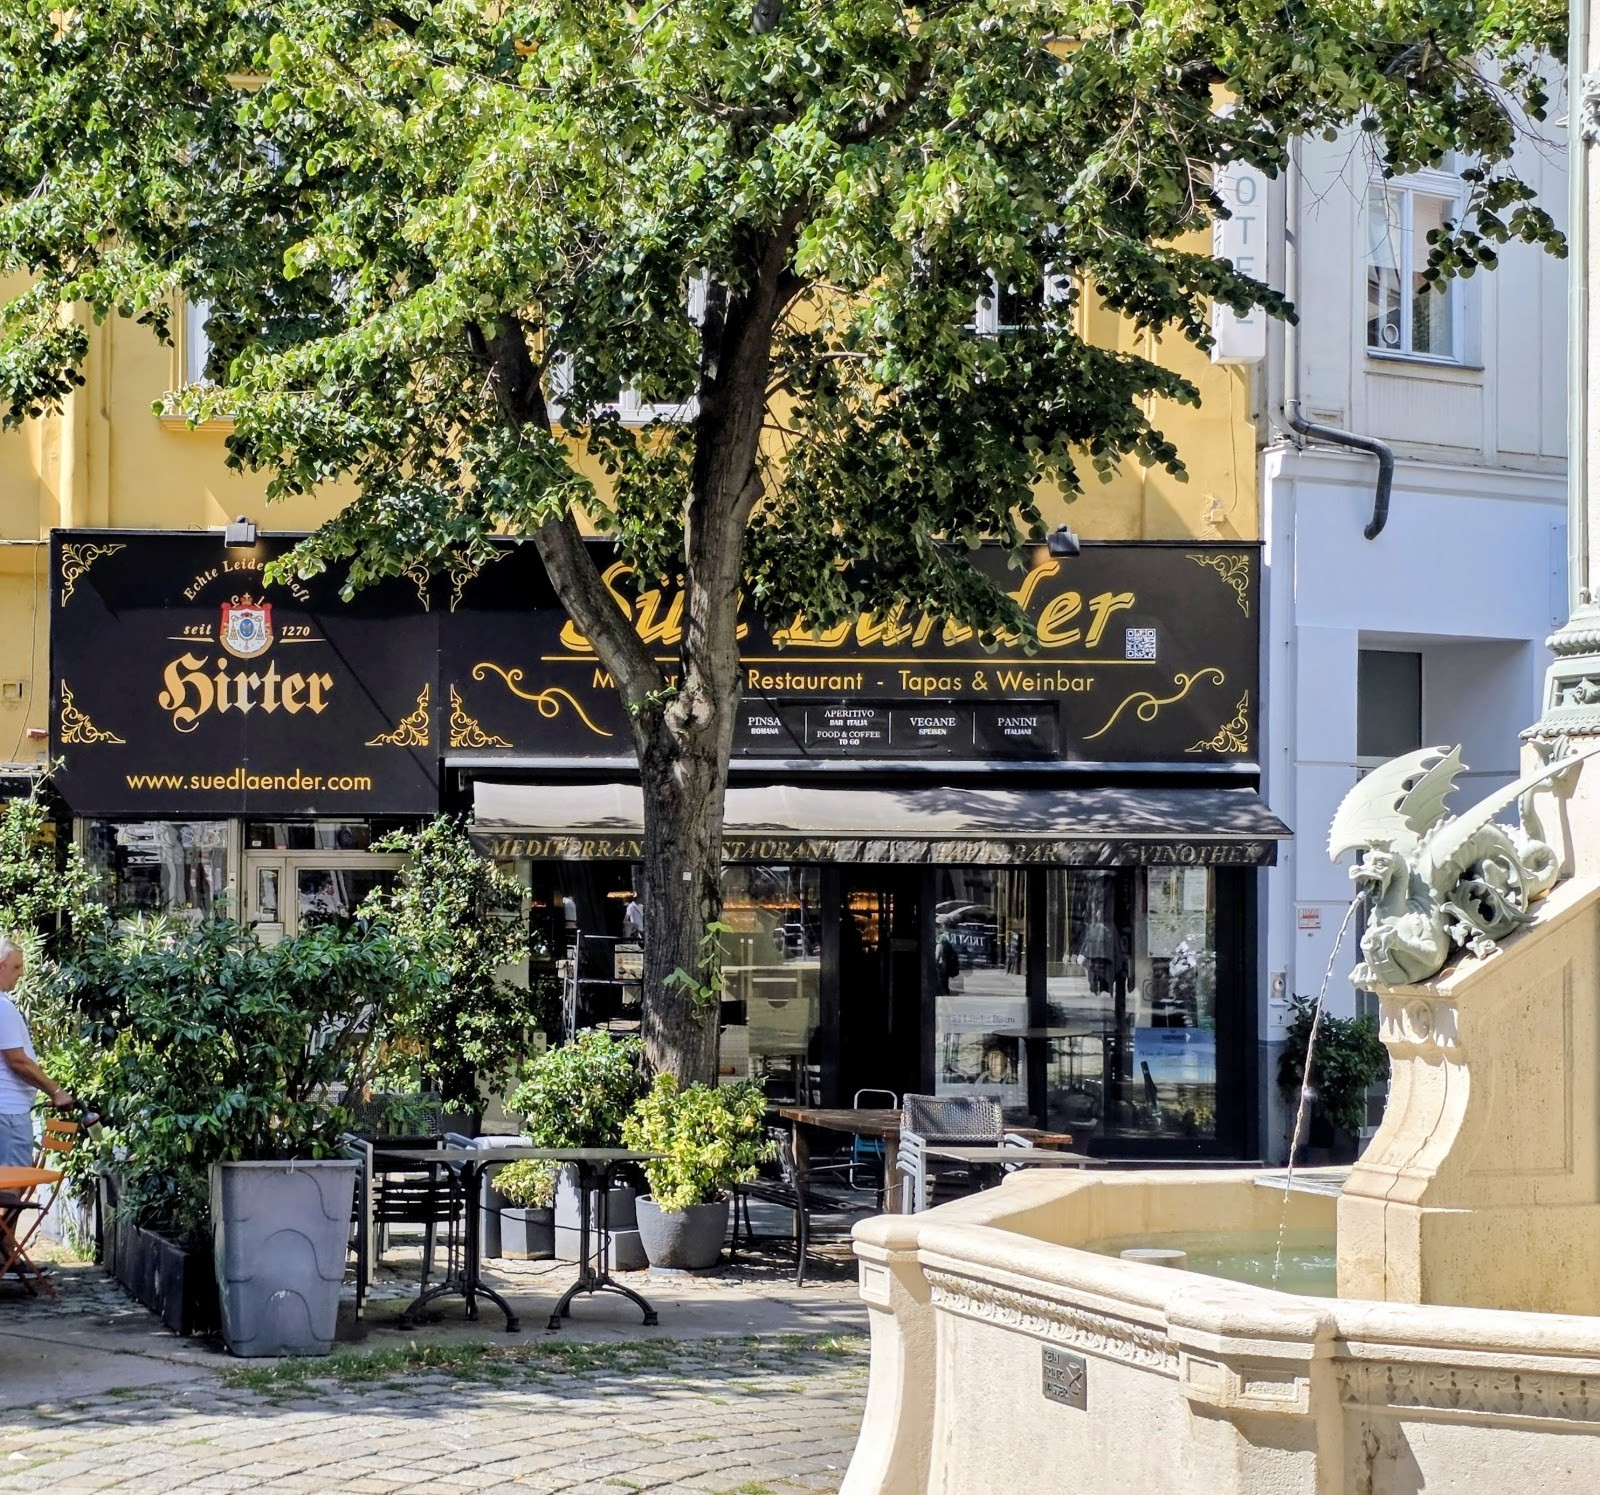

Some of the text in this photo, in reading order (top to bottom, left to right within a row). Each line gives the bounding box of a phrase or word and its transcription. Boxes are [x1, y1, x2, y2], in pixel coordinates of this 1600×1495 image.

[1235, 175, 1258, 325] OTE
[183, 557, 311, 603] Echte Leidehaft
[559, 558, 759, 653] Sü
[183, 623, 311, 637] seit 1270
[748, 669, 863, 691] Restaurant
[899, 670, 963, 696] Tapas
[971, 671, 988, 691] &
[996, 669, 1095, 692] Weinbar
[158, 652, 334, 733] Hirter
[748, 717, 781, 726] PINSA
[824, 709, 875, 718] APERITIVO
[909, 717, 956, 727] VEGANE
[997, 717, 1037, 727] PANINI
[816, 730, 881, 738] FOOD & COFFEE
[126, 768, 372, 791] www.suedlaender.com
[488, 839, 646, 858] MEDITERRAN
